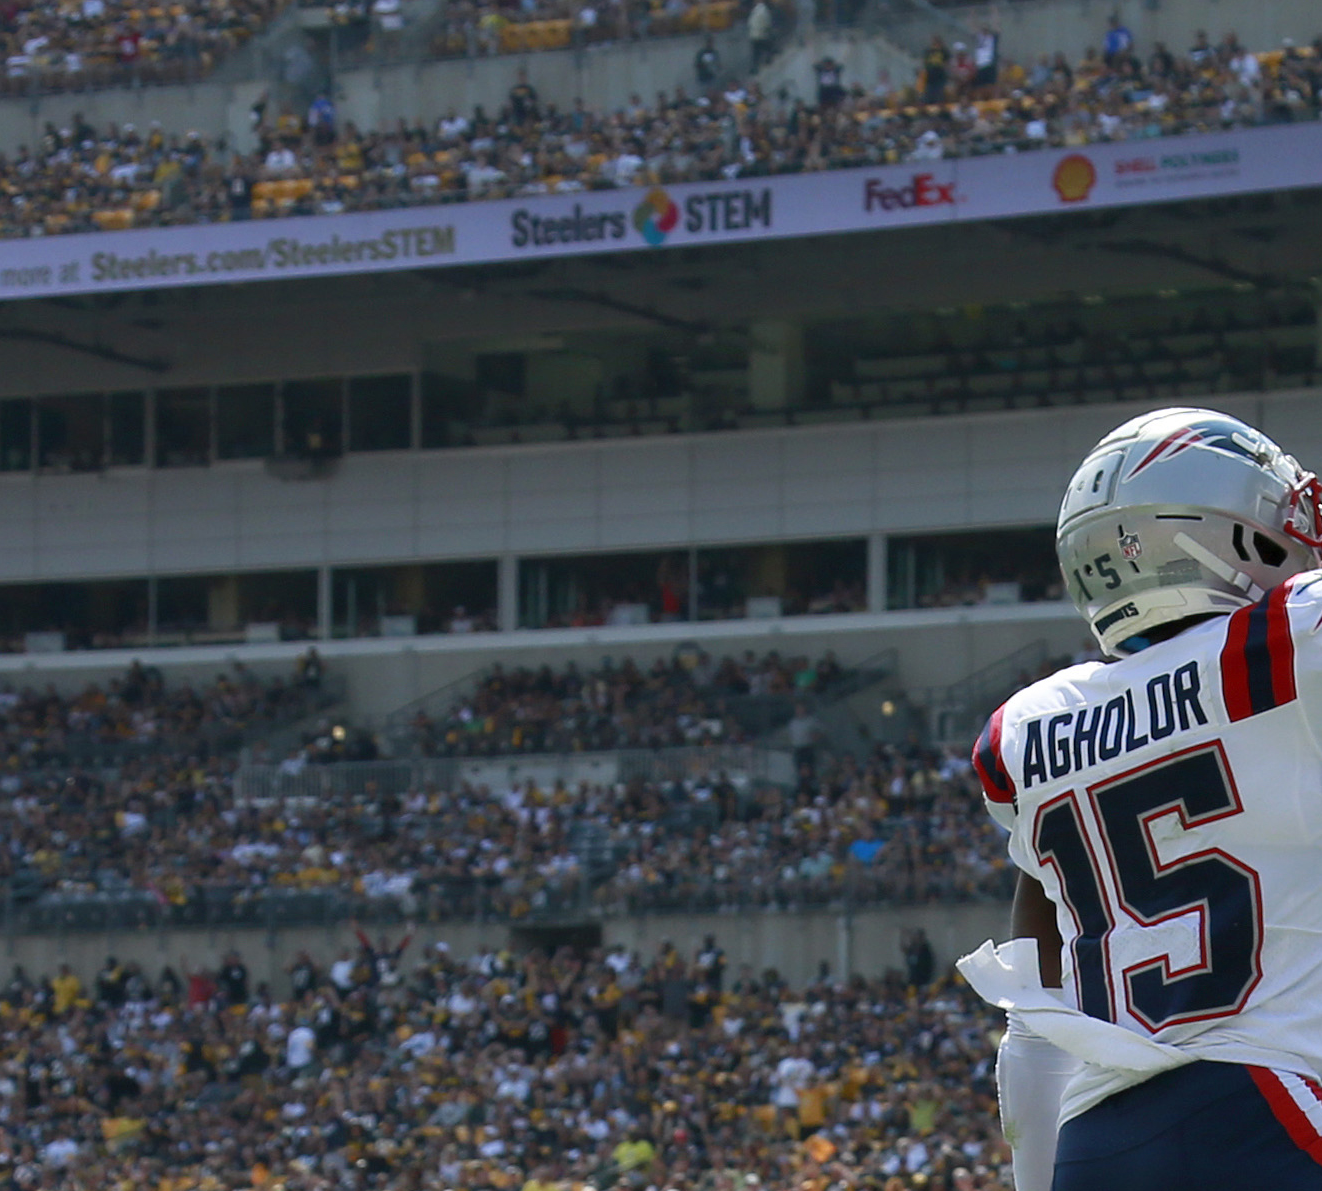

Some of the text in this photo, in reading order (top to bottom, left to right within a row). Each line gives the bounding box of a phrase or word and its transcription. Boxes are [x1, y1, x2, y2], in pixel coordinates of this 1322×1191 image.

[511, 187, 772, 248] Steelers STEM
[864, 173, 955, 213] FedEx
[0, 266, 53, 288] more
[59, 260, 81, 284] at
[92, 225, 457, 281] Steelers.com/SteelersSTEM
[1122, 541, 1142, 559] NFL
[1023, 660, 1209, 788] AGHOLOR
[1032, 738, 1263, 1034] 15
